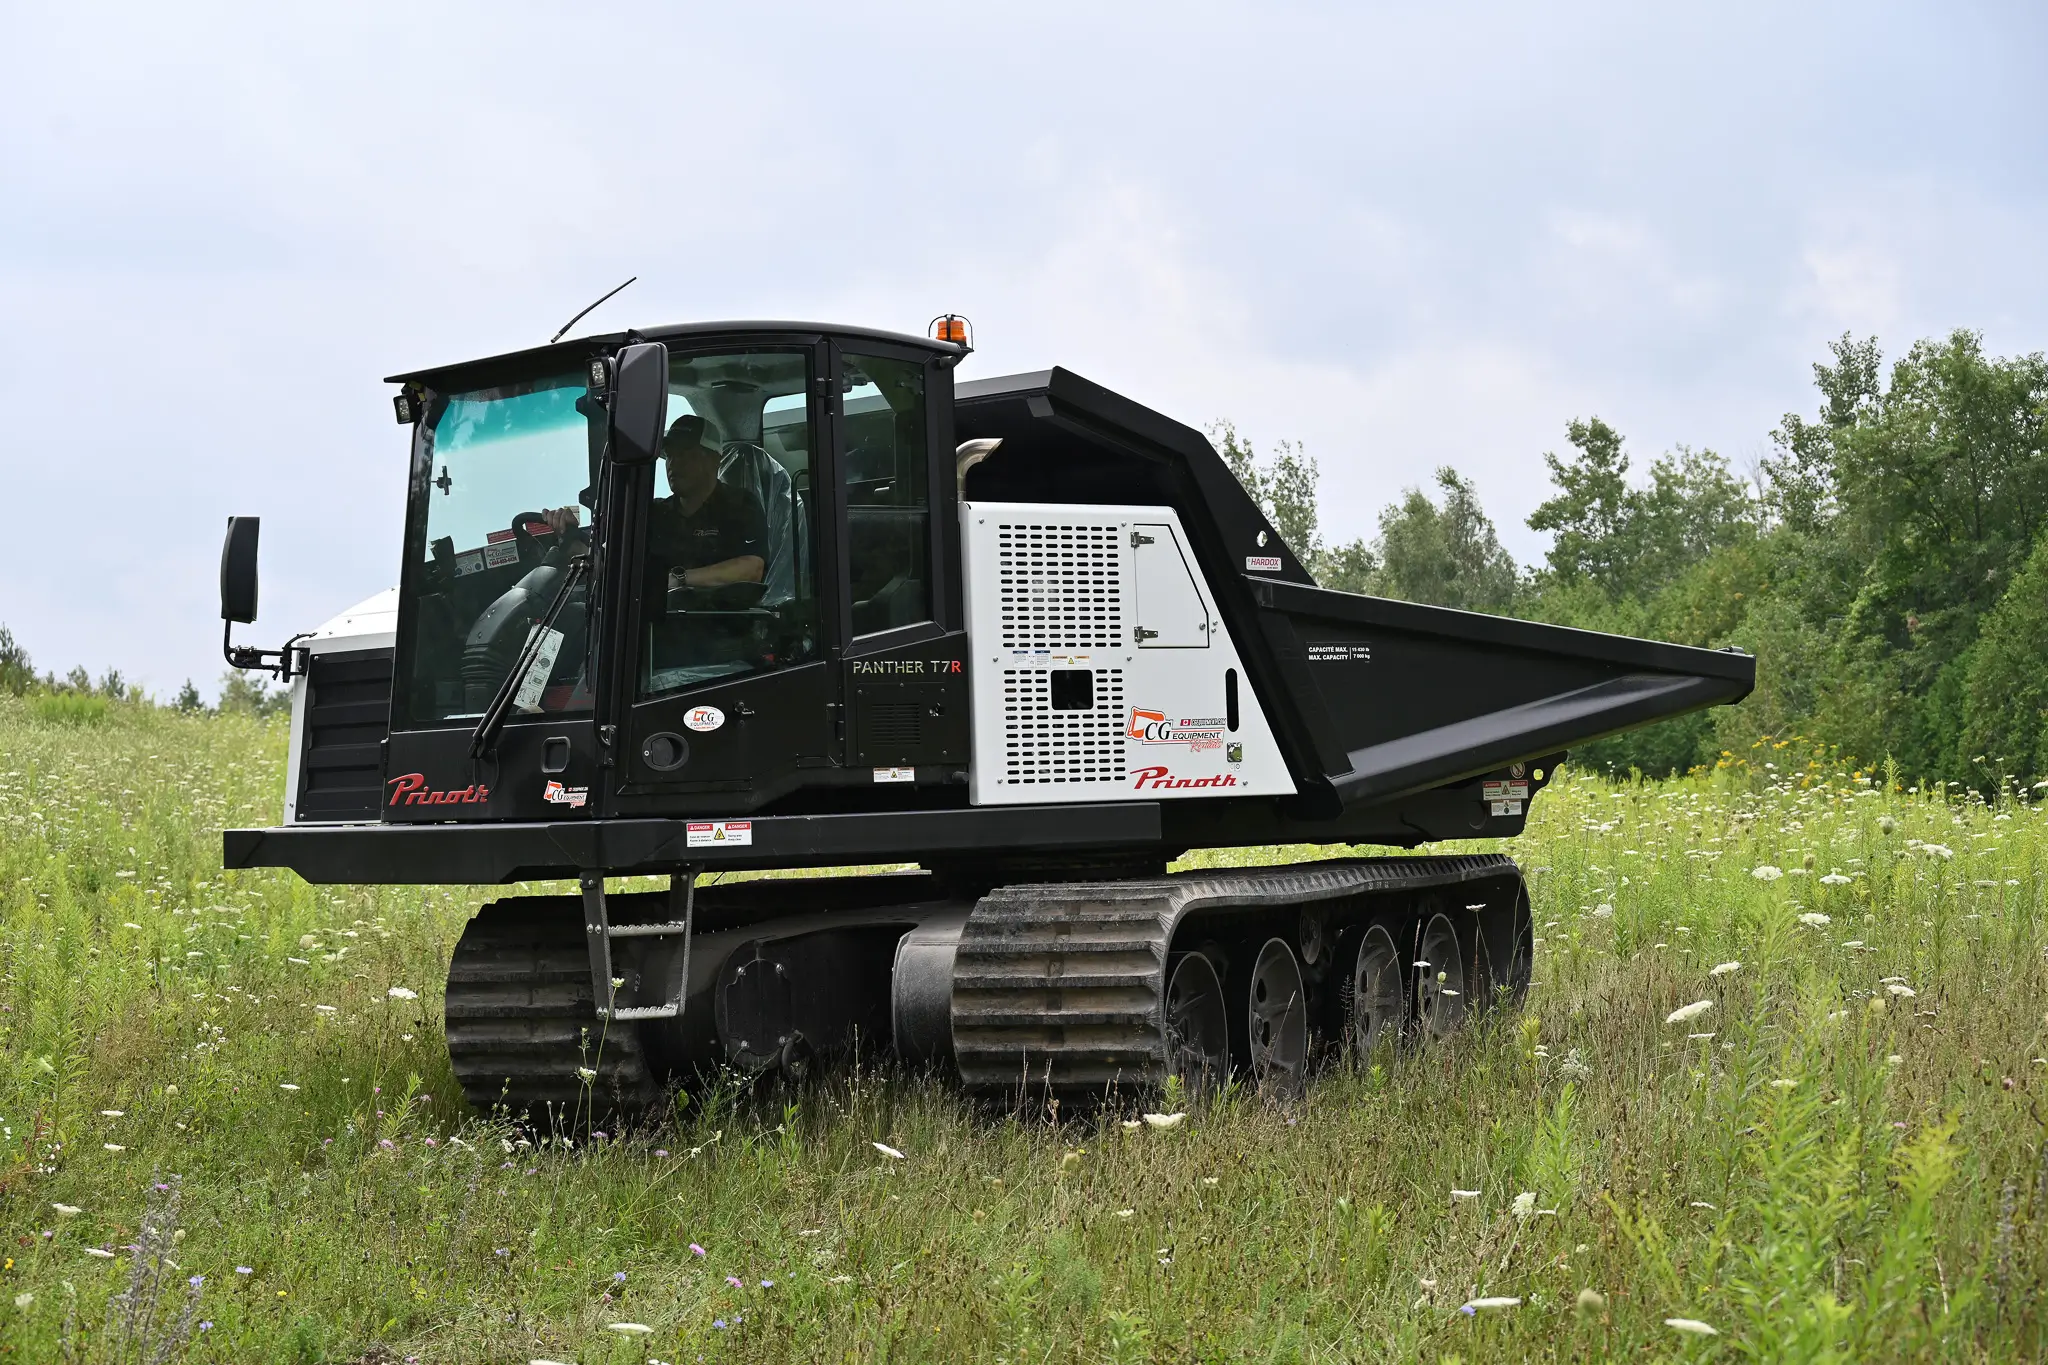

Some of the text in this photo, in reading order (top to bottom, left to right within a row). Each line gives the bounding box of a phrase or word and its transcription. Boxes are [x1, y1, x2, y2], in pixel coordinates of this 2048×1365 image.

[1251, 558, 1279, 566] HARDOX
[853, 660, 961, 674] PANTHER T7R
[701, 712, 715, 722] CG
[1145, 722, 1172, 740] CG
[1172, 731, 1220, 739] EQUIPMENT
[1129, 766, 1237, 790] Prinoth
[387, 773, 489, 806] Prinoth
